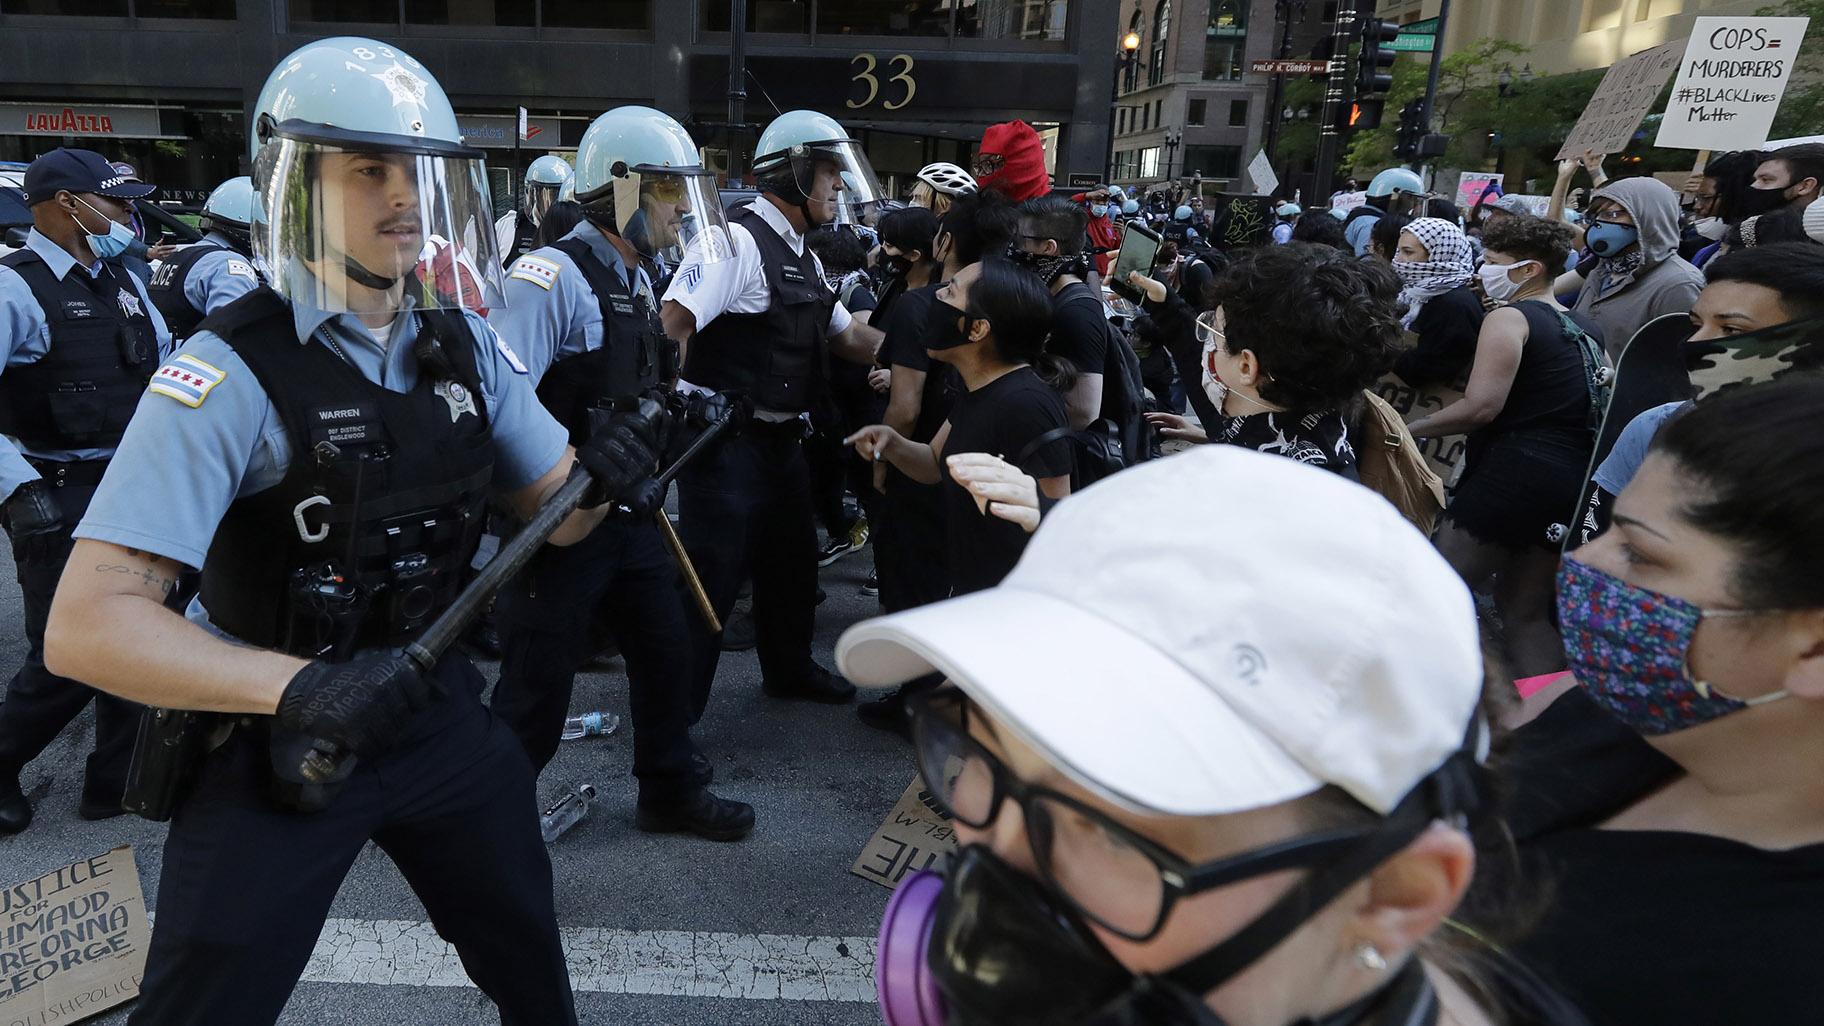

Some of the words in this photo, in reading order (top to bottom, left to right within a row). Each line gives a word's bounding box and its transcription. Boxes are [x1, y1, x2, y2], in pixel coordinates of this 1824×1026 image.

[1252, 63, 1274, 72] PHILIP
[1689, 59, 1783, 78] MURDERERS
[846, 53, 916, 109] 33
[26, 108, 113, 133] LAVAZZA
[1688, 106, 1737, 121] Matter
[319, 408, 360, 420] WARREN
[329, 432, 365, 441] ENGLEWOOD
[340, 425, 366, 434] DISTRICT
[10, 900, 49, 922] FOR
